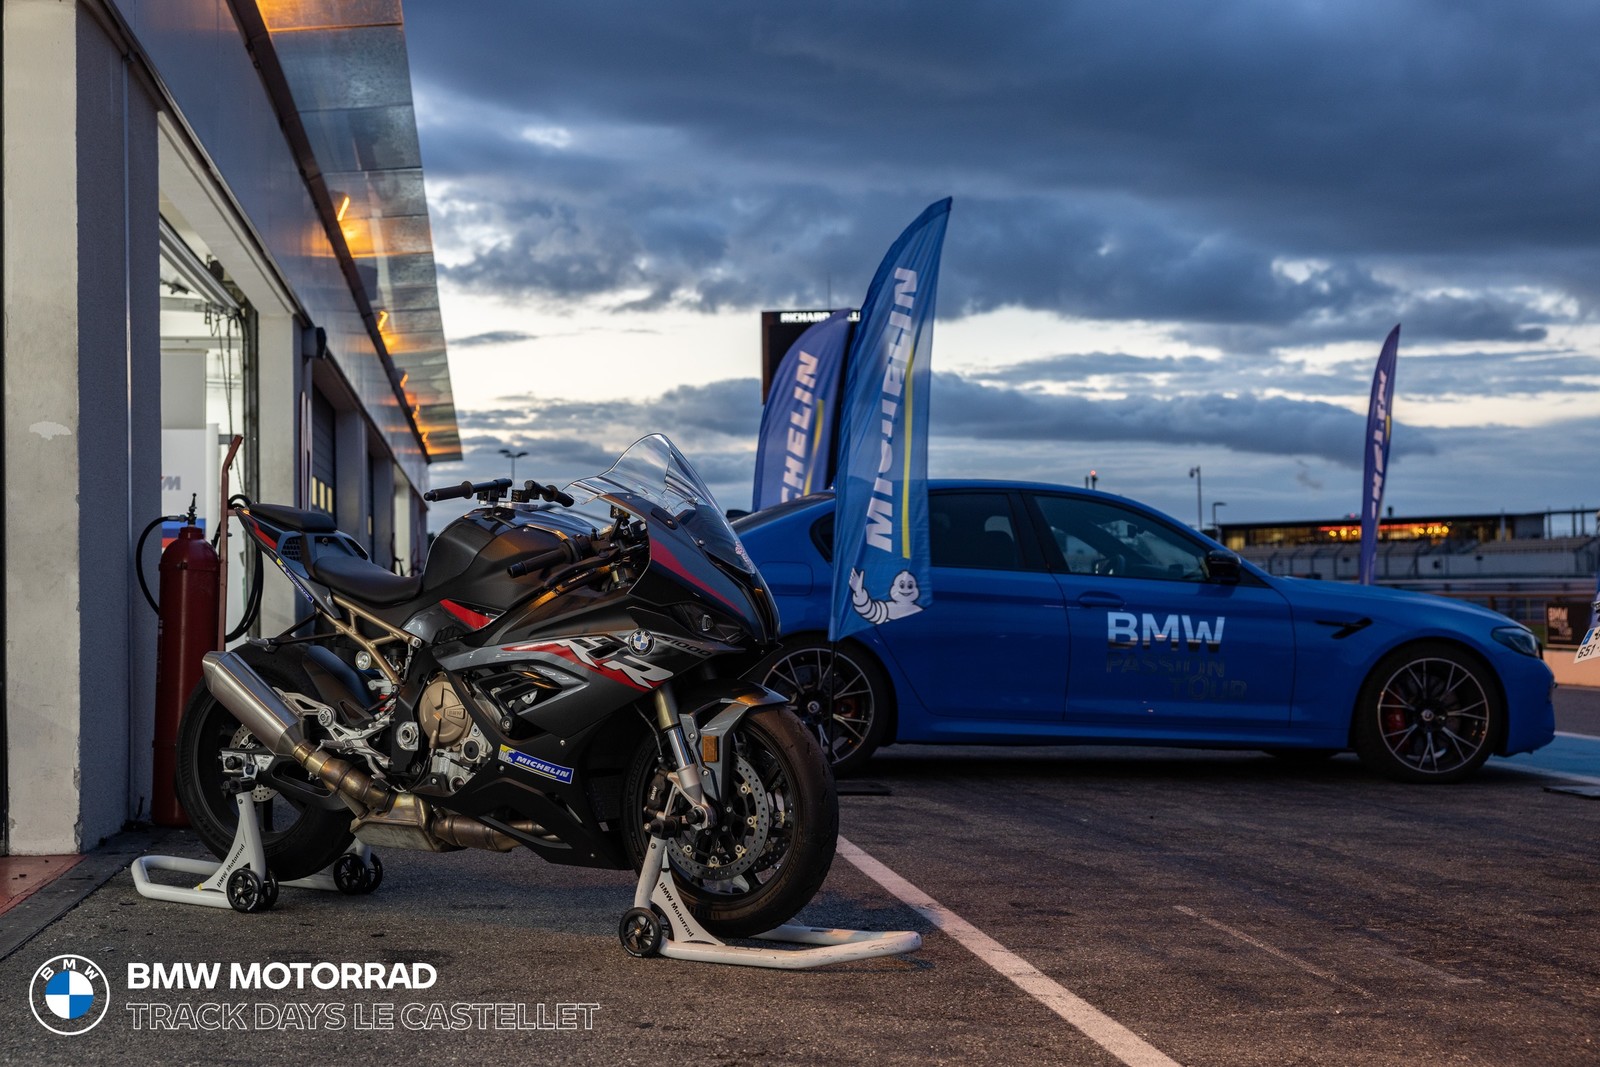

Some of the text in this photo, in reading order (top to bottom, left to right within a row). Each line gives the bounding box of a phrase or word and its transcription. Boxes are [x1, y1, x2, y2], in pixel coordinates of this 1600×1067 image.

[1107, 611, 1225, 653] BMW
[1105, 653, 1226, 678] PASSION
[1168, 673, 1248, 701] TOUR
[516, 755, 570, 778] MICHELIN
[216, 843, 245, 888] BMW Motorrad
[659, 882, 695, 938] BMW Motorrad
